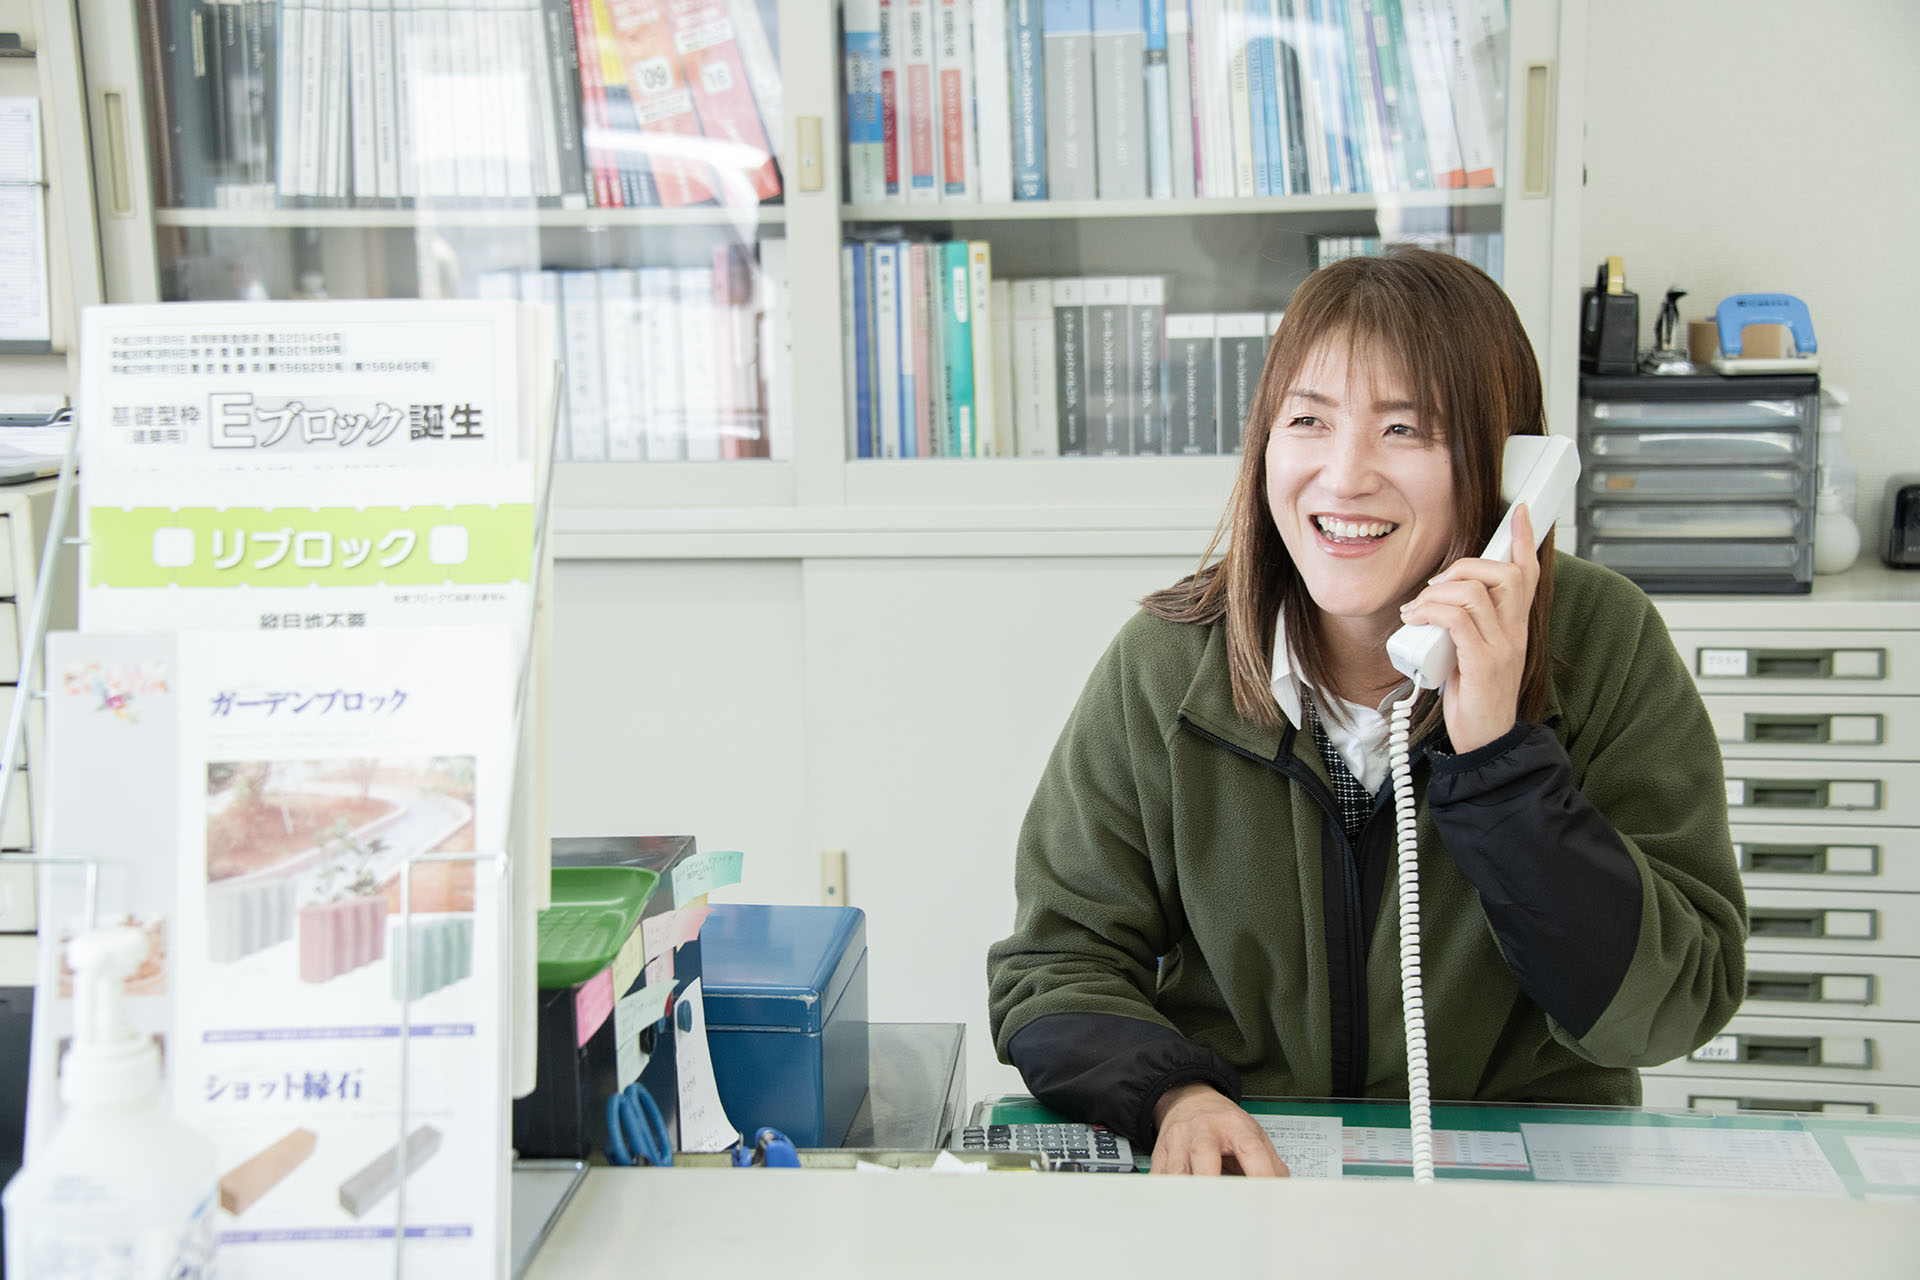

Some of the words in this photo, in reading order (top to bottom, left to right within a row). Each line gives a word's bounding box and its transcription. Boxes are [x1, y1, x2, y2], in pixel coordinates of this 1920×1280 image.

[208, 392, 405, 449] Eブロック
[408, 402, 485, 441] 誕生
[212, 526, 418, 571] リブロック
[210, 688, 409, 718] ガーデンブロック
[204, 1067, 365, 1102] ショット縁石
